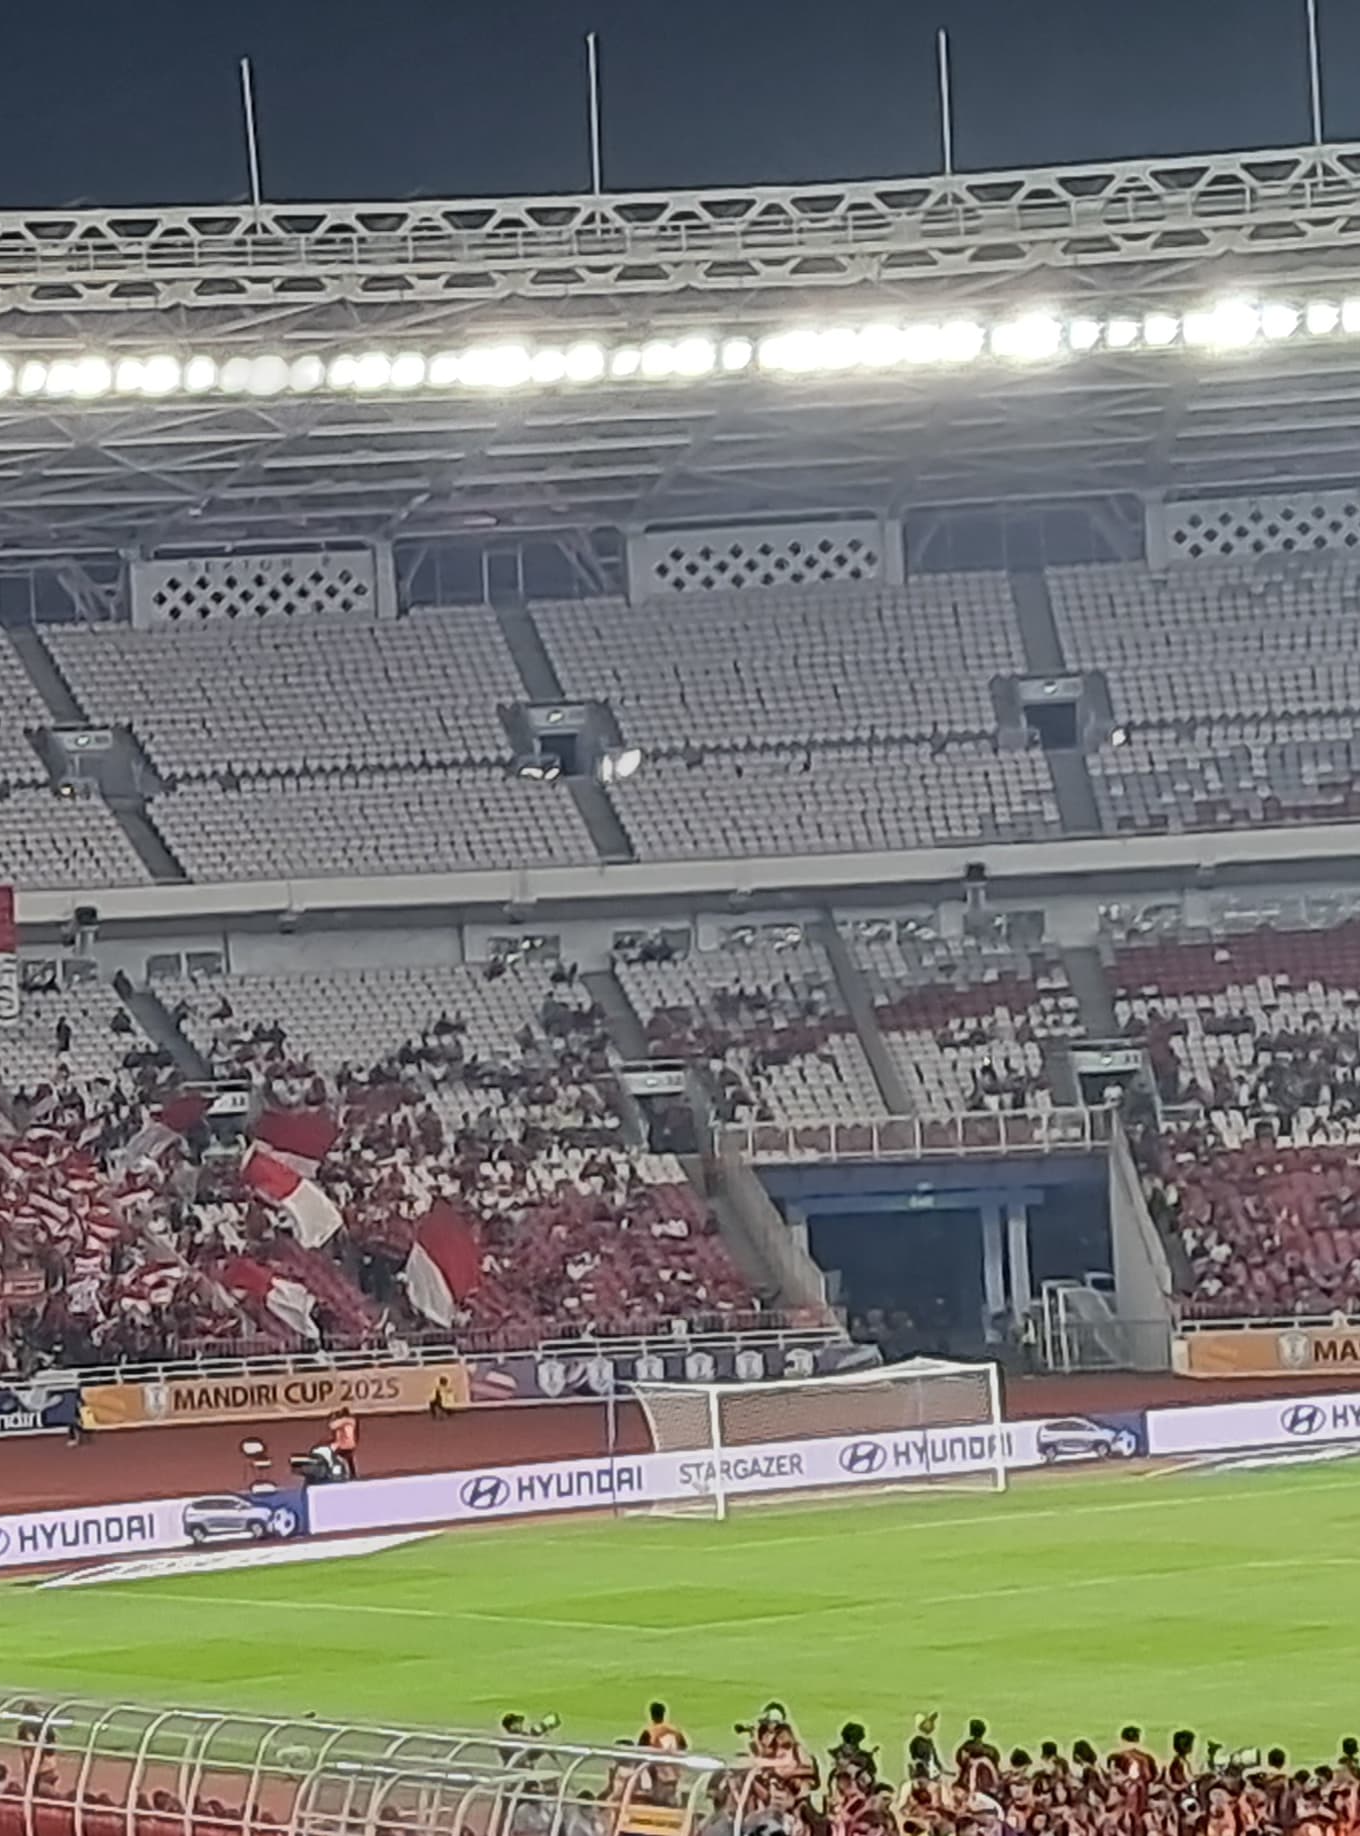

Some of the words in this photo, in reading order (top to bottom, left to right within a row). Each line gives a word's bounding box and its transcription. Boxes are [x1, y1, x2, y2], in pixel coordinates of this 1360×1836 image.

[1313, 1339, 1360, 1362] MA
[173, 1383, 278, 1411] MANDIRI
[283, 1380, 334, 1404] CUP
[340, 1376, 400, 1401] 2025
[517, 1465, 643, 1501] HYUNDAI
[679, 1453, 804, 1485] STARGAZER
[18, 1513, 155, 1552] HYUNDAI
